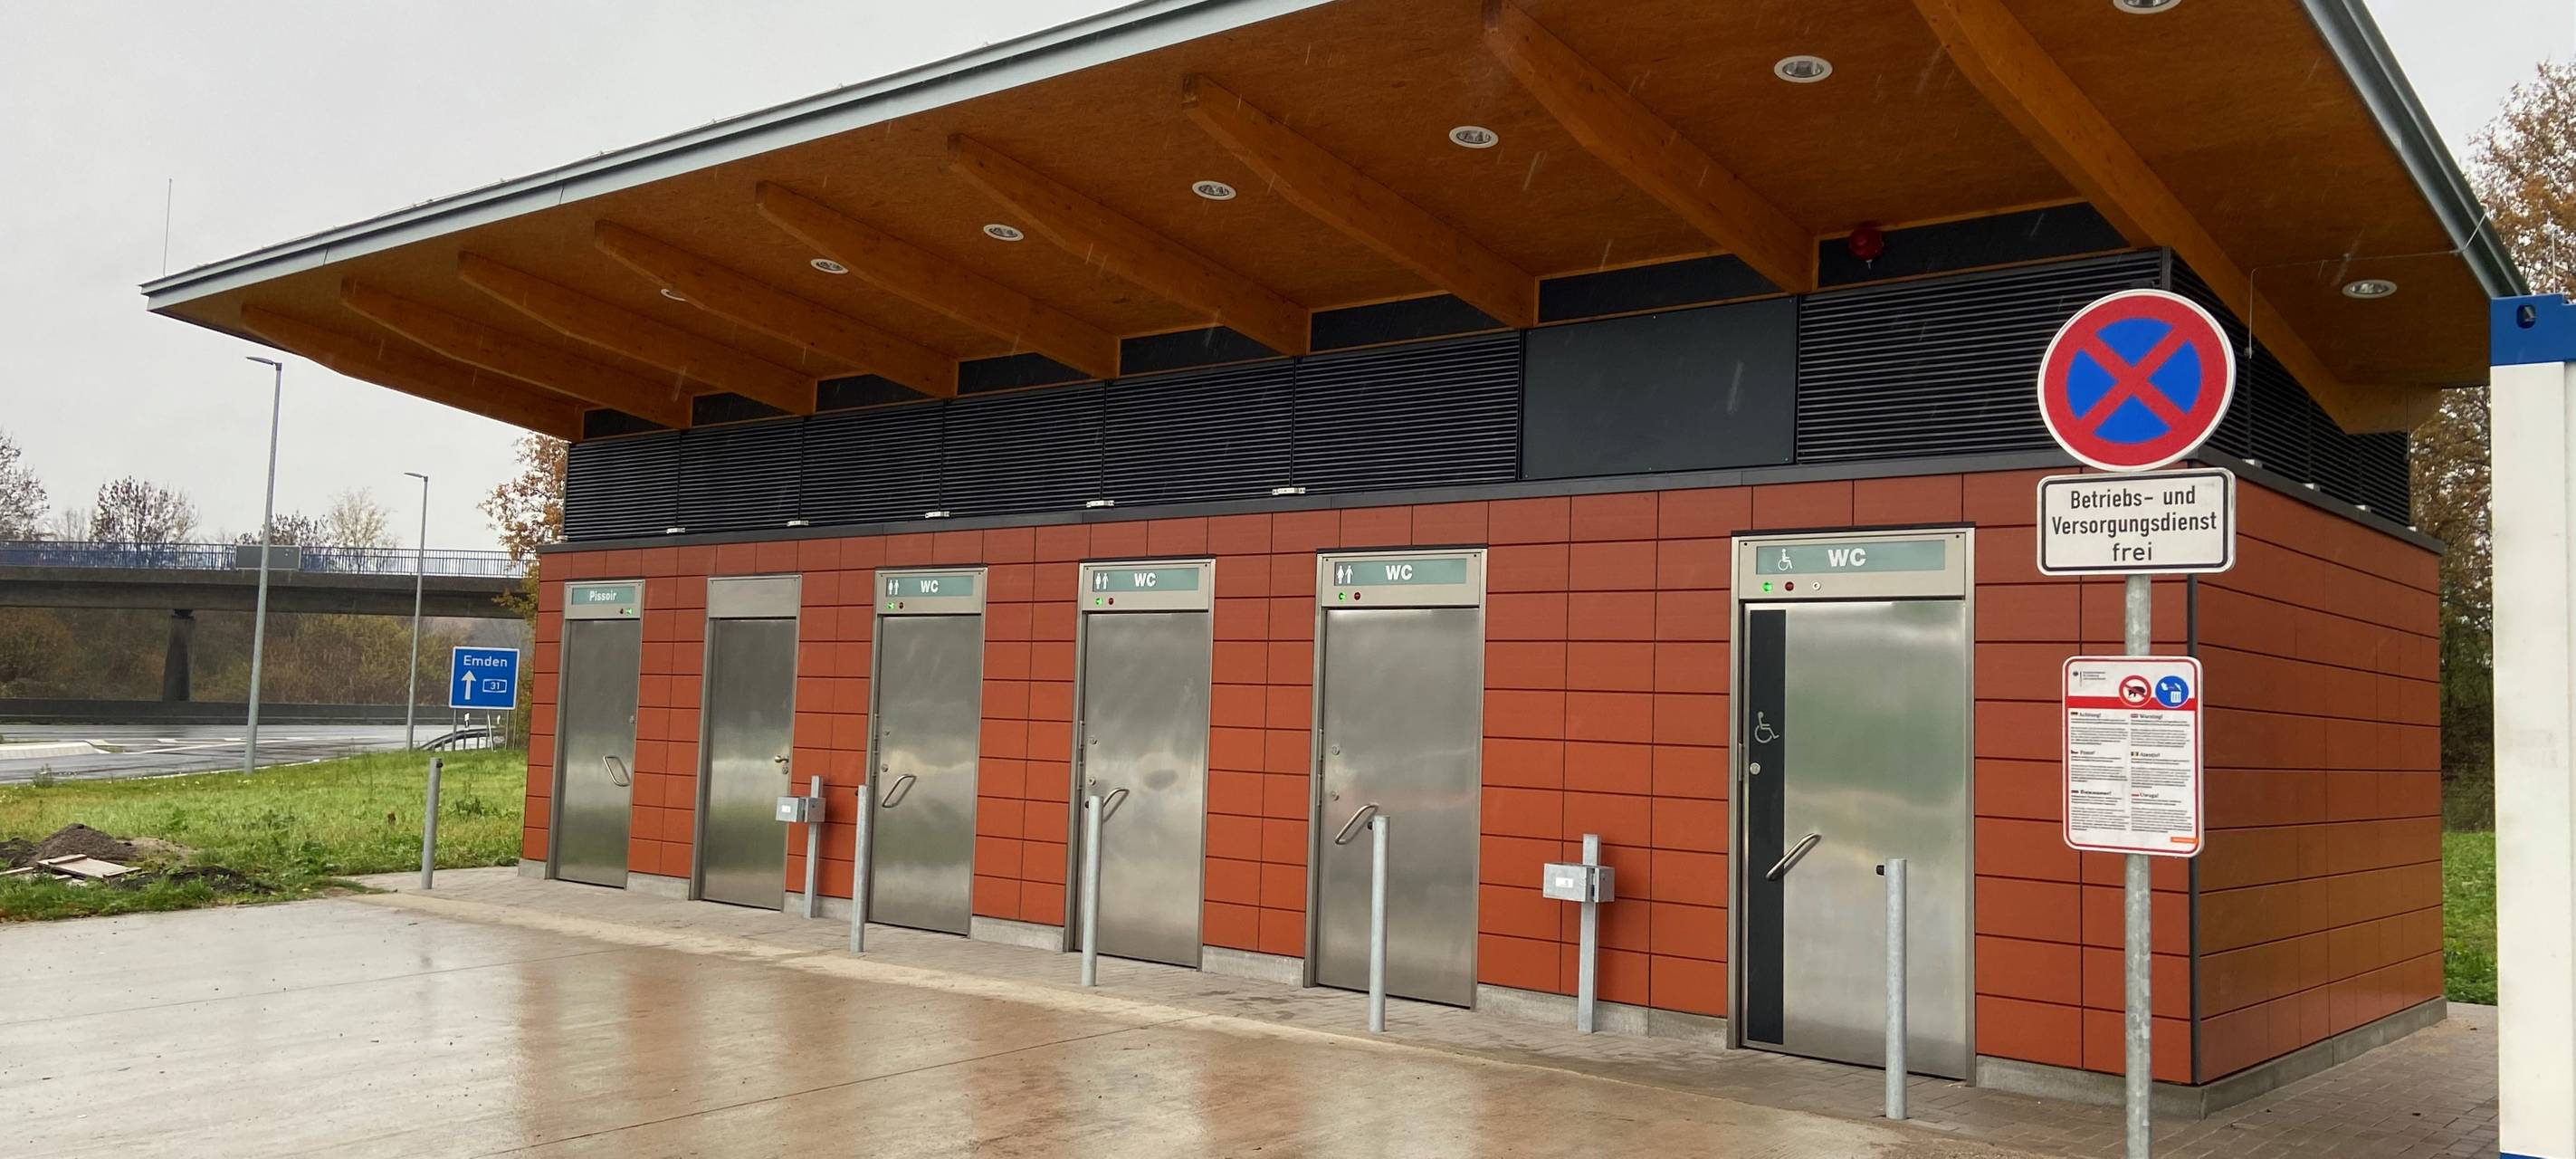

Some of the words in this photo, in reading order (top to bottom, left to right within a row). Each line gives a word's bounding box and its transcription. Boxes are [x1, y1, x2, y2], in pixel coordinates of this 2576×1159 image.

[2070, 488, 2154, 510] Betriebs-
[2163, 485, 2196, 506] und
[2052, 512, 2217, 538] Versorgungsdienst
[1827, 548, 1866, 568] WC
[2113, 541, 2152, 562] frei
[1133, 572, 1157, 588] WC
[1385, 564, 1413, 580] WC
[920, 580, 939, 593] WC
[588, 589, 617, 602] Pissoir
[463, 655, 508, 667] Emden
